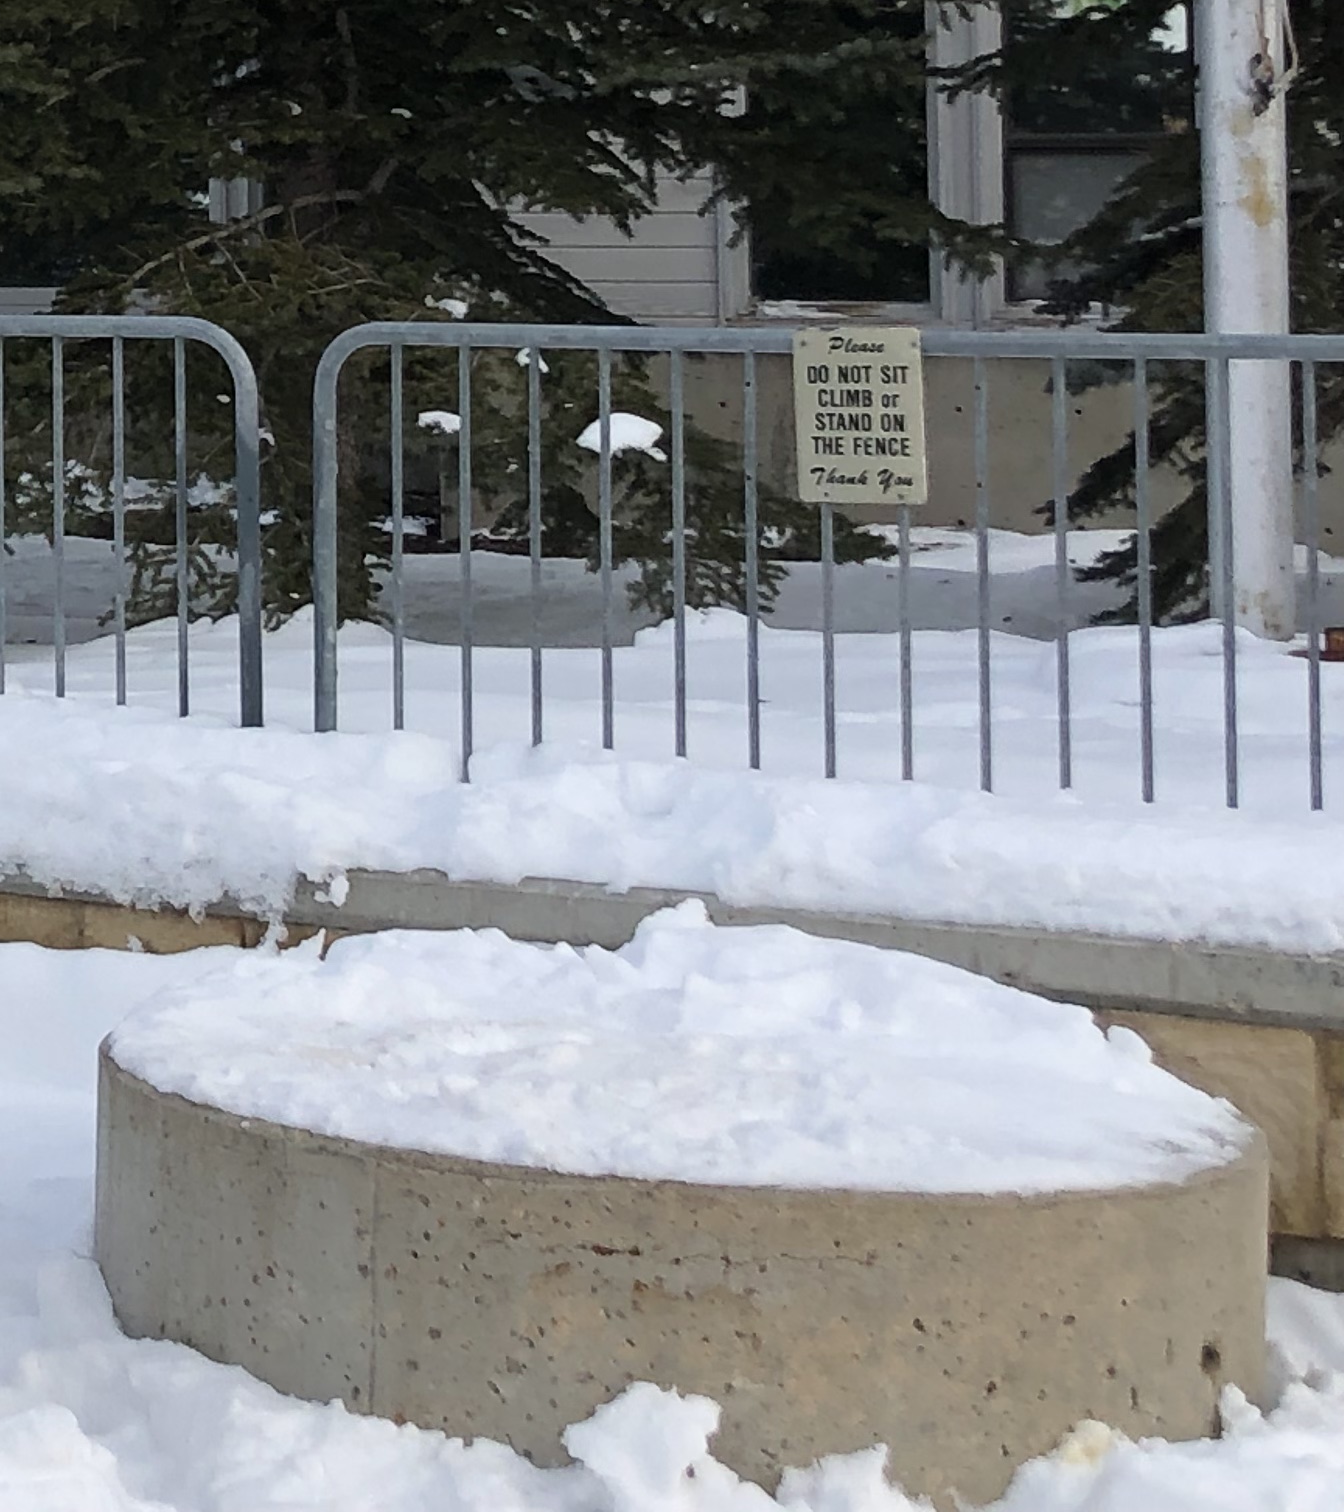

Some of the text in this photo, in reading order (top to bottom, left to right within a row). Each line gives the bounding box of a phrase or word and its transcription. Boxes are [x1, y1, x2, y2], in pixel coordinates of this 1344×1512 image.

[828, 336, 885, 355] Please
[807, 365, 909, 384] DO NOT SIT
[818, 389, 899, 408] CLIMB or
[814, 412, 905, 432] STAND ON
[811, 436, 911, 457] THE FENCE
[810, 466, 914, 494] Thank You
